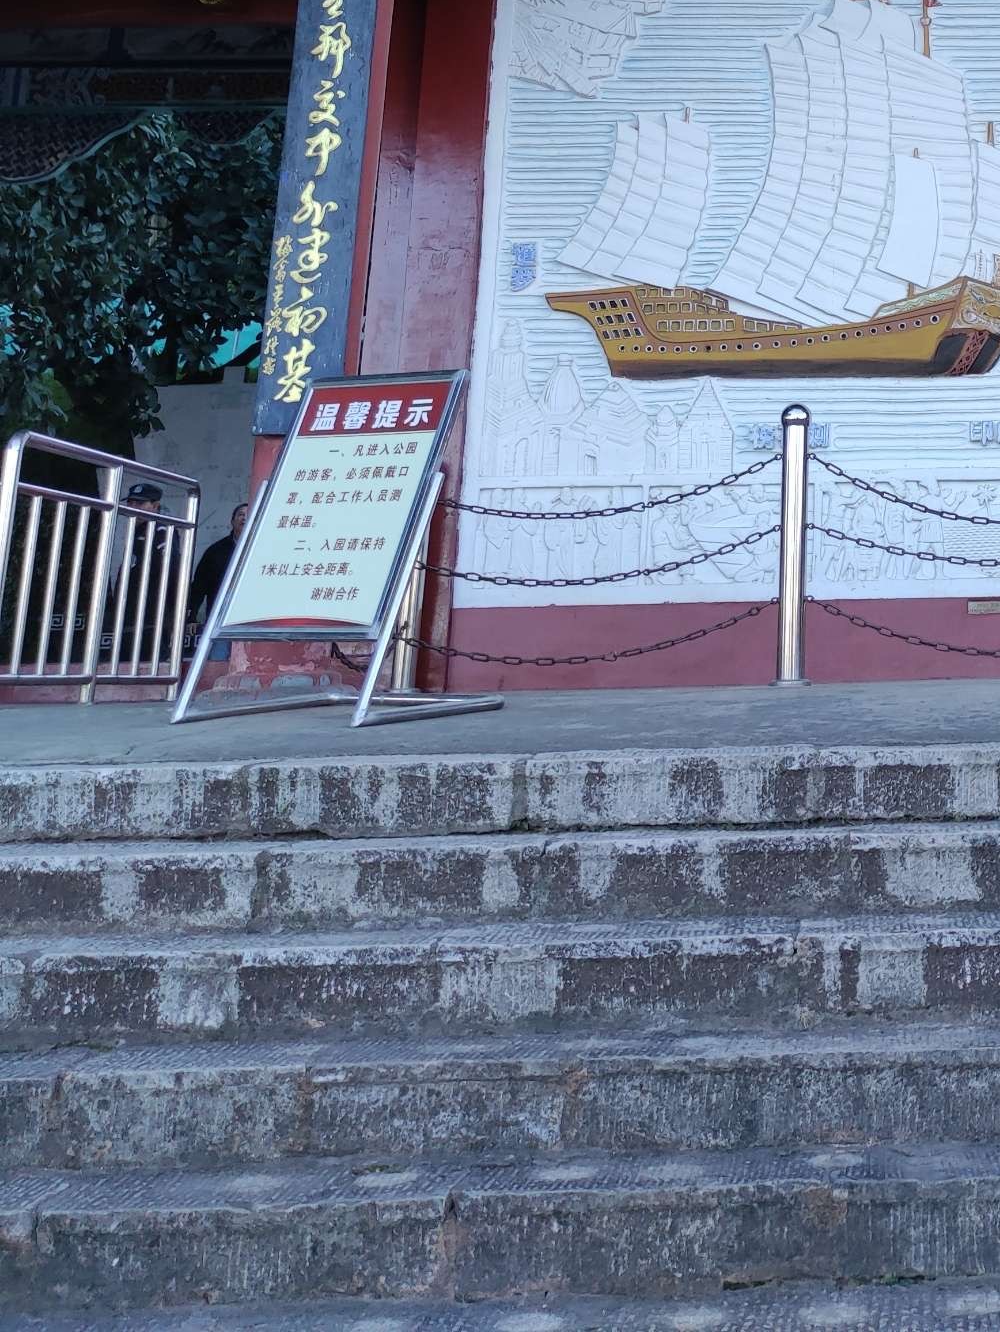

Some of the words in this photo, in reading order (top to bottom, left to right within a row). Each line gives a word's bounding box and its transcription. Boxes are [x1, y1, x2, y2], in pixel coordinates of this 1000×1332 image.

[310, 398, 434, 432] 温馨提示
[311, 587, 360, 601] 谢谢合作
